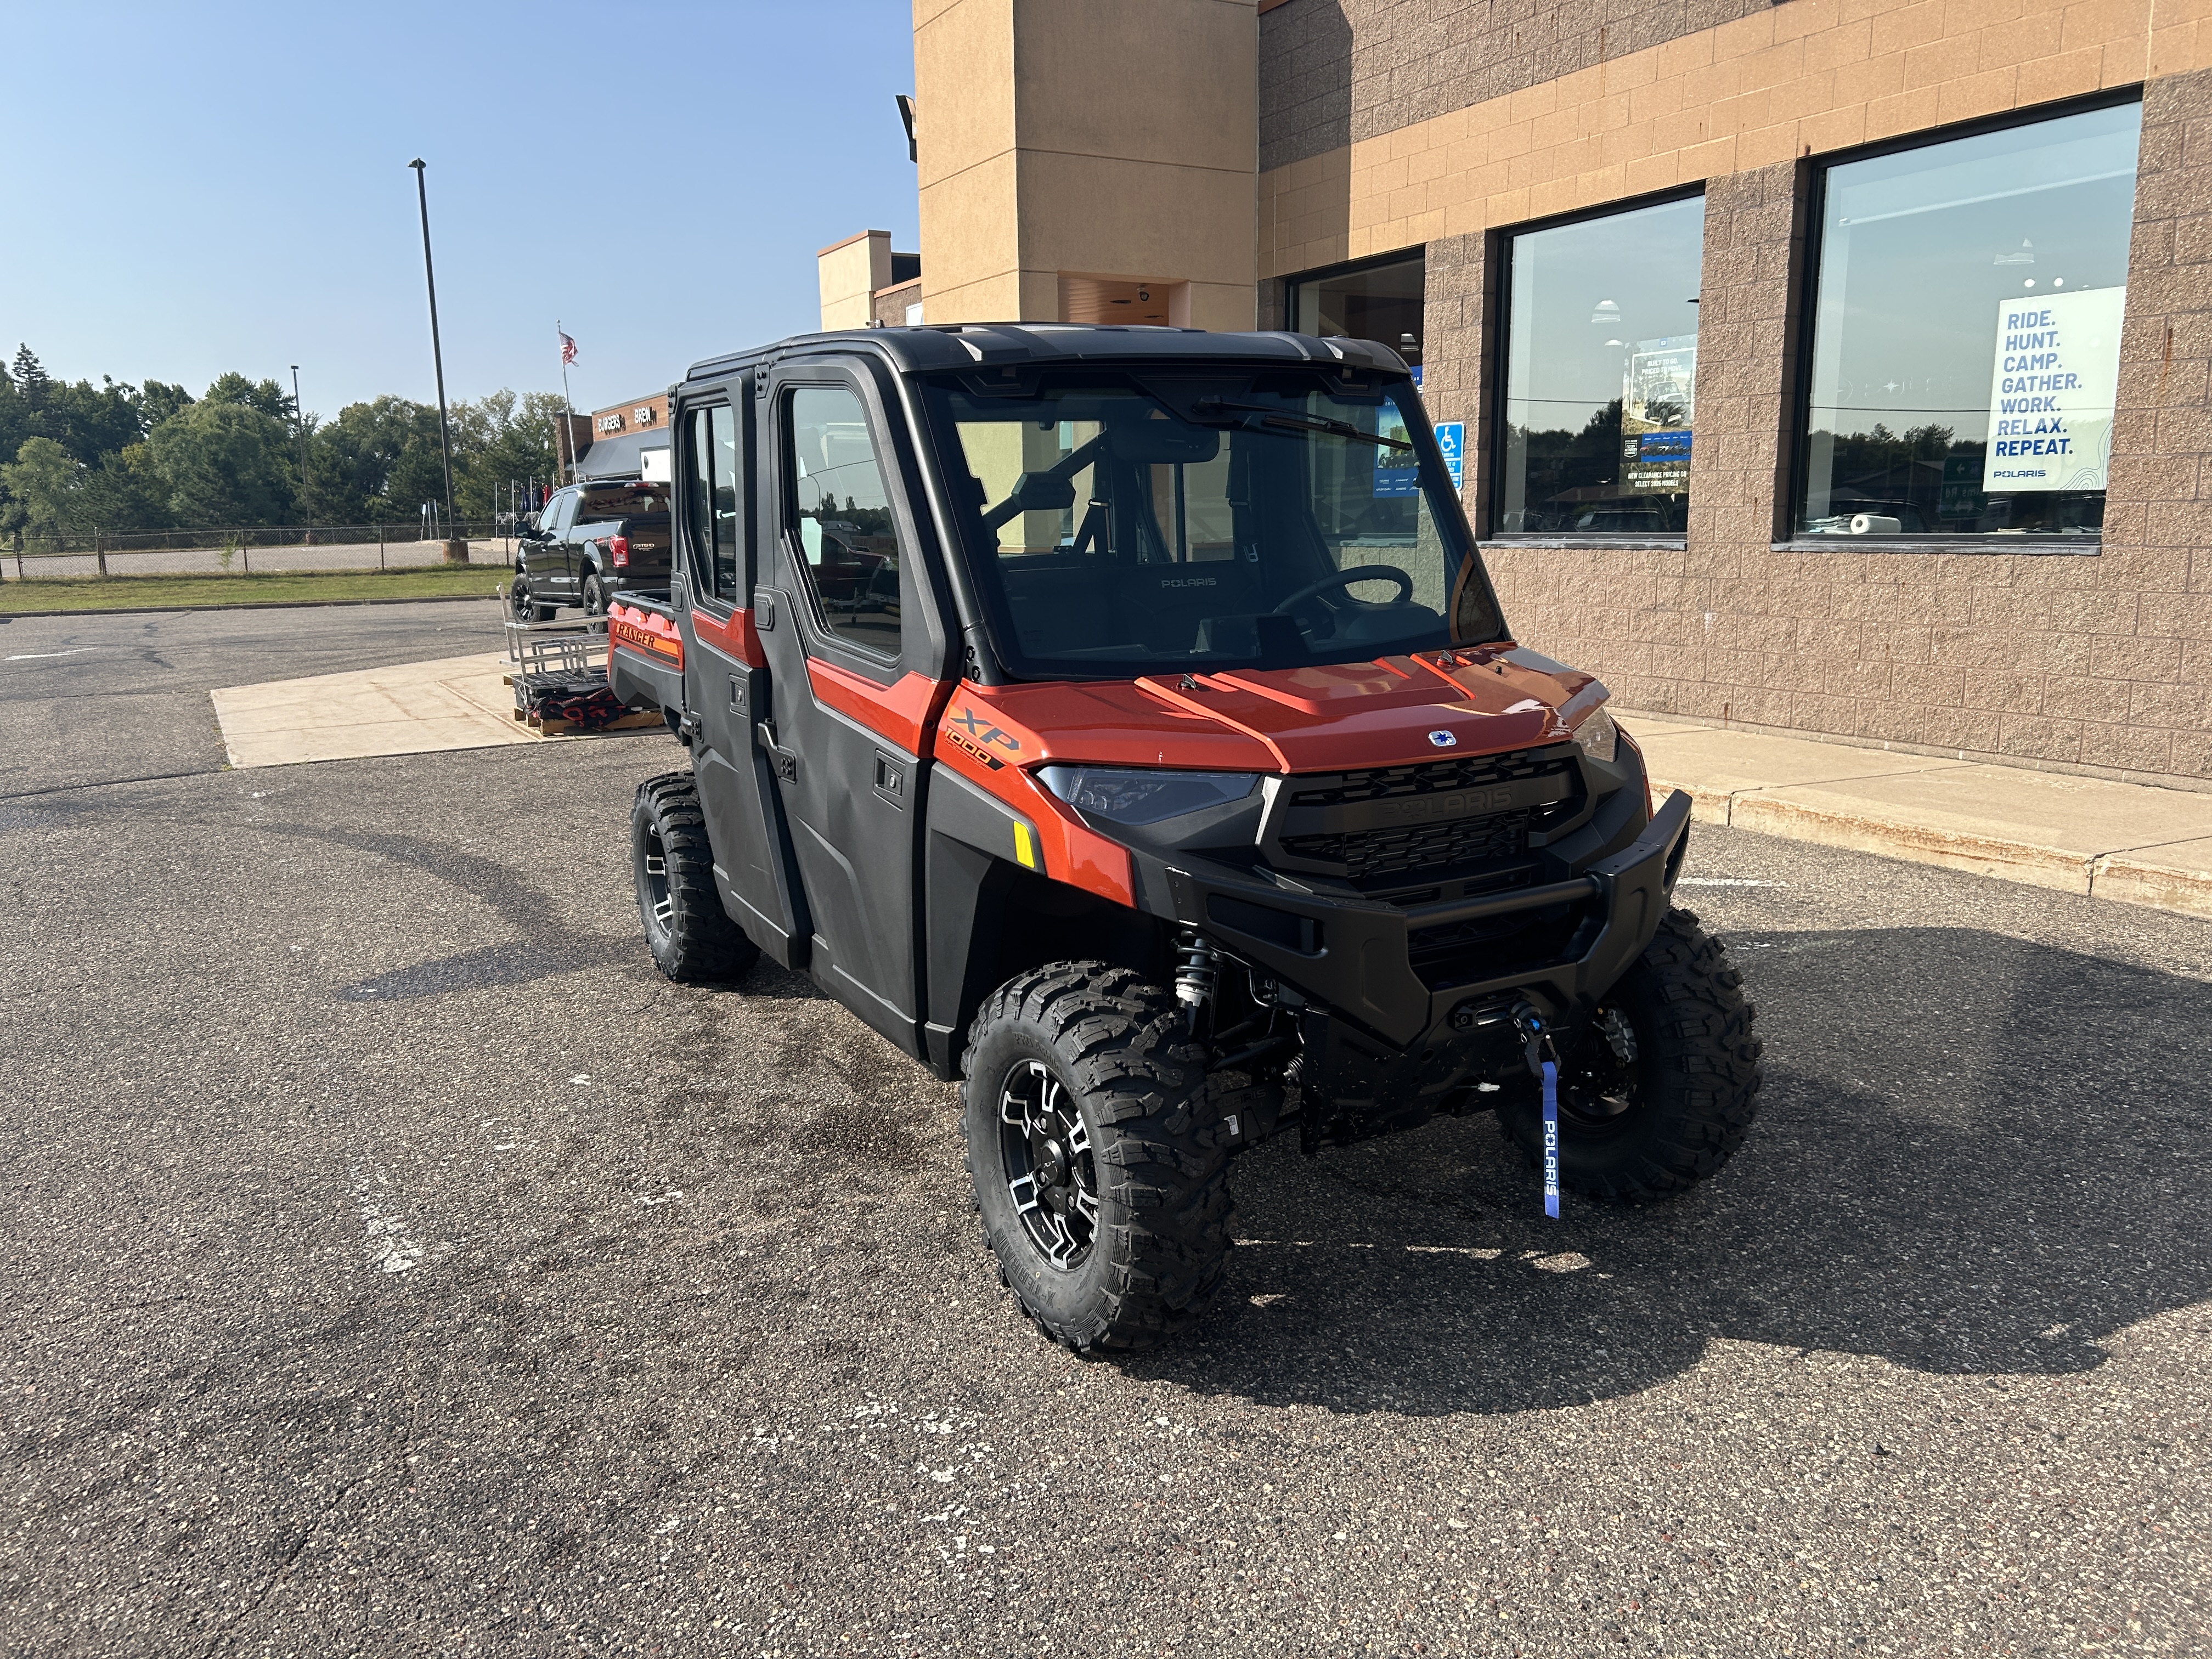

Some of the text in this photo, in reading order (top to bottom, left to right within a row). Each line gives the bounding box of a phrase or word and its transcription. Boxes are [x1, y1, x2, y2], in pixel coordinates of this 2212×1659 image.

[2007, 310, 2056, 330] RIDE.
[2005, 331, 2061, 351] HUNT.
[2004, 353, 2062, 373] CAMP.
[2001, 373, 2083, 393] GATHER.
[635, 407, 651, 424] BREW
[2000, 396, 2061, 415] WORK.
[598, 414, 620, 432] BURGERS
[1997, 417, 2067, 436] RELAX.
[1995, 438, 2073, 456] REPEAT.
[1993, 470, 2046, 478] POLARIS
[1161, 578, 1217, 588] POLARIS
[618, 623, 655, 647] RANGER
[949, 707, 1019, 751] XP
[944, 727, 992, 764] 1000
[1378, 786, 1512, 820] POLARIS
[1545, 1120, 1557, 1197] POLARIS
[994, 1226, 1056, 1308] X-TERRAIN
